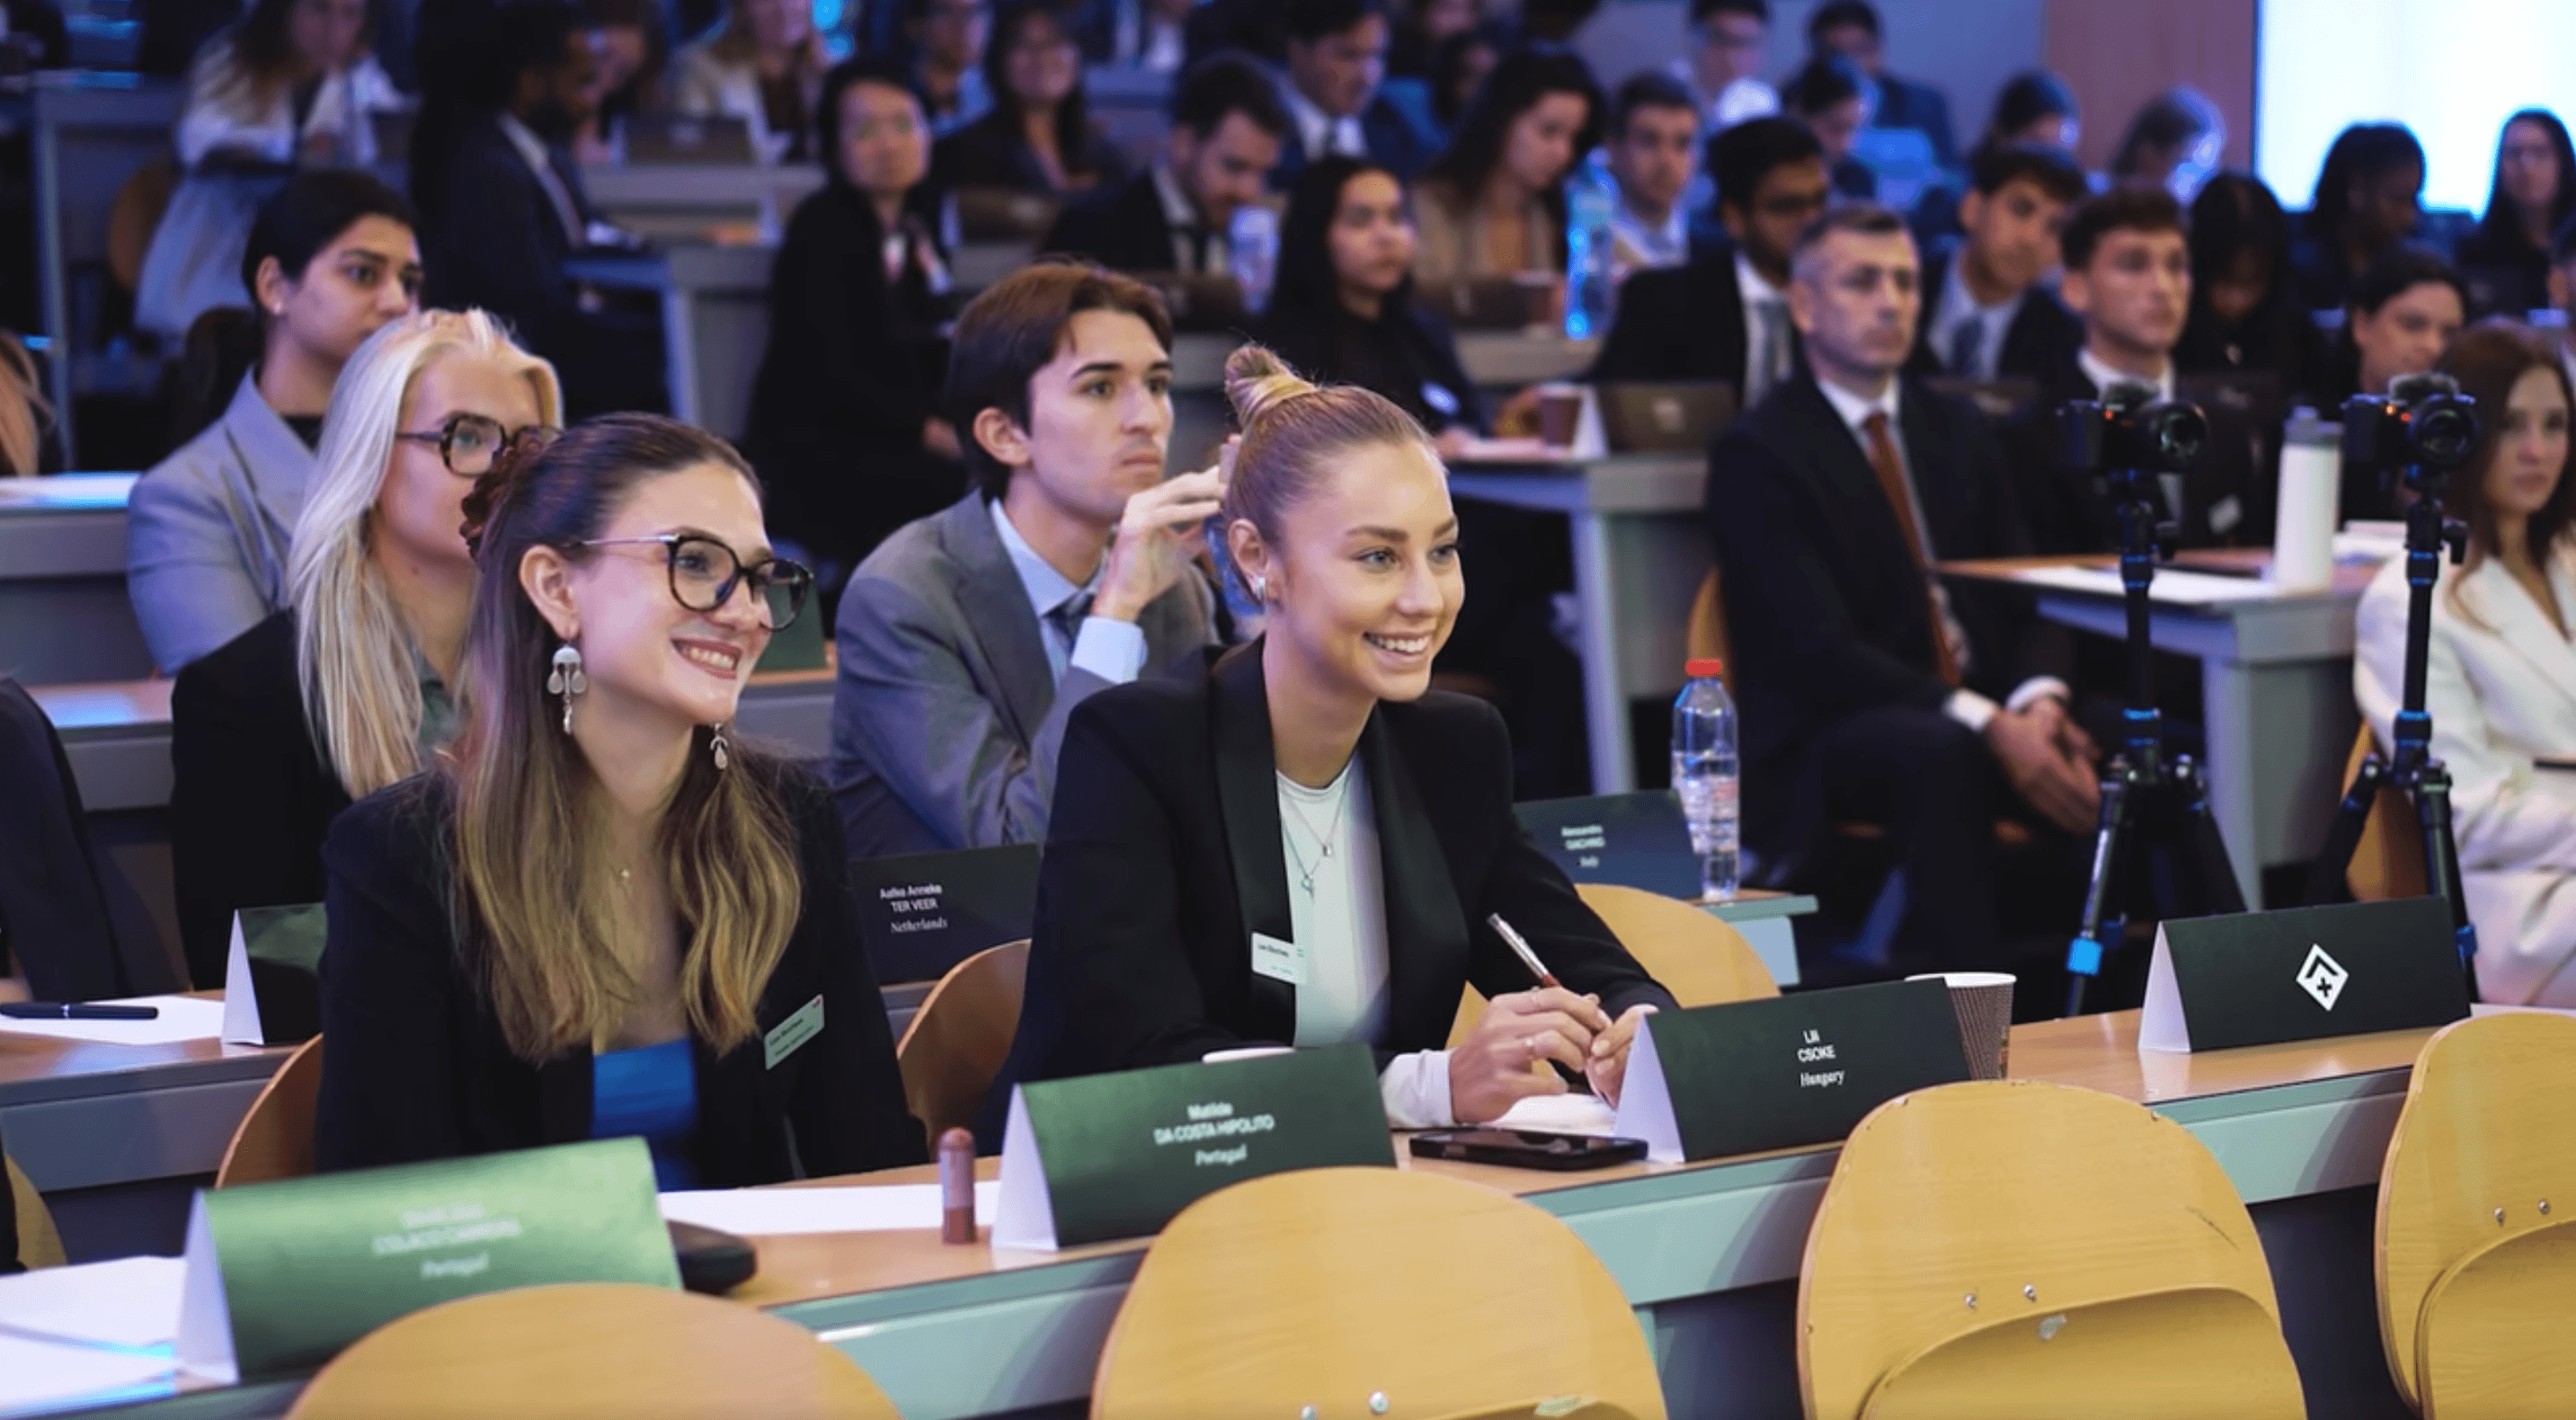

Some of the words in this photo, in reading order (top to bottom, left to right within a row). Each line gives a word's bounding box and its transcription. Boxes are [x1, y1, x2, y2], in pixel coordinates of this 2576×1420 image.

[891, 900, 910, 913] TER
[911, 897, 938, 910] VEER
[891, 917, 949, 933] Netherlands
[1800, 1070, 1845, 1087] Hungary
[1174, 1123, 1215, 1142] COSTA
[1195, 1143, 1248, 1167] Portugal
